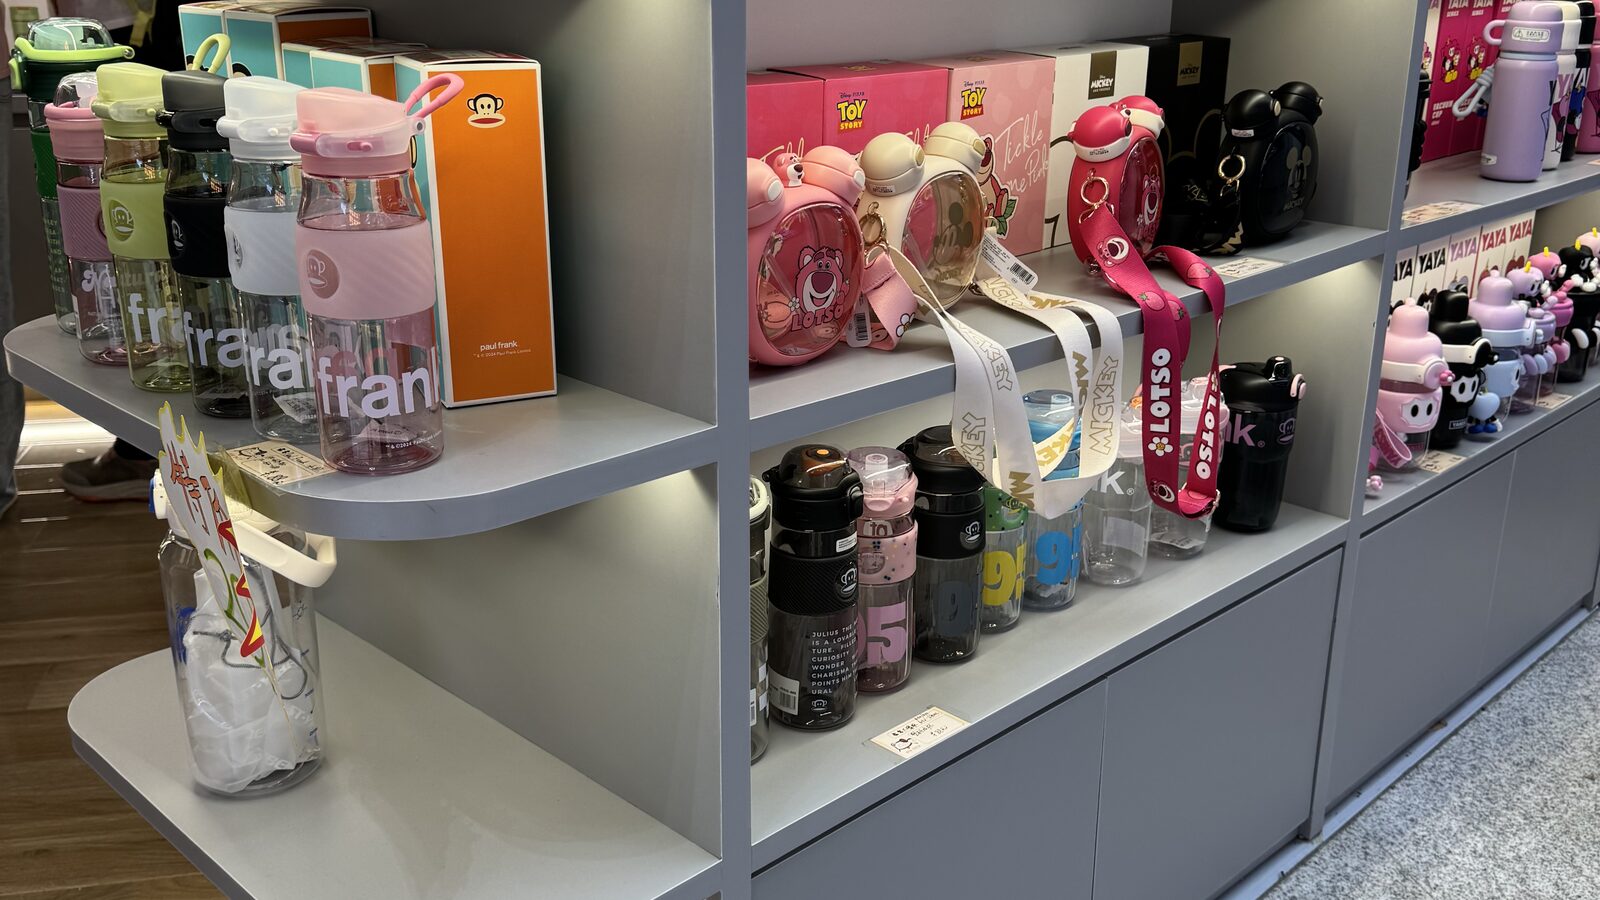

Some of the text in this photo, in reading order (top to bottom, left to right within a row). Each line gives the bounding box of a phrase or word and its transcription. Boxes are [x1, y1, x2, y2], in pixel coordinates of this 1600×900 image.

[1090, 78, 1114, 89] MICKEY
[961, 87, 987, 109] TOY
[837, 98, 868, 122] TOY
[963, 107, 983, 117] STORY
[840, 121, 863, 130] STORY
[1481, 228, 1507, 252] YAYA
[1510, 219, 1533, 242] YAYA
[1418, 247, 1446, 275] YAYA
[1450, 237, 1478, 262] YAYA
[791, 304, 844, 332] LOTSO
[182, 311, 246, 368] fra
[480, 340, 518, 352] paul frank
[1150, 348, 1171, 433] LOTSO
[1089, 355, 1119, 456] MICKEY
[1194, 396, 1217, 480] LOTSO
[812, 629, 839, 638] JULIUS
[863, 601, 907, 666] 5
[811, 650, 850, 662] CURIOSITY
[812, 660, 845, 670] WONDER
[811, 667, 850, 679] CHARISMA
[811, 678, 840, 687] POINTS
